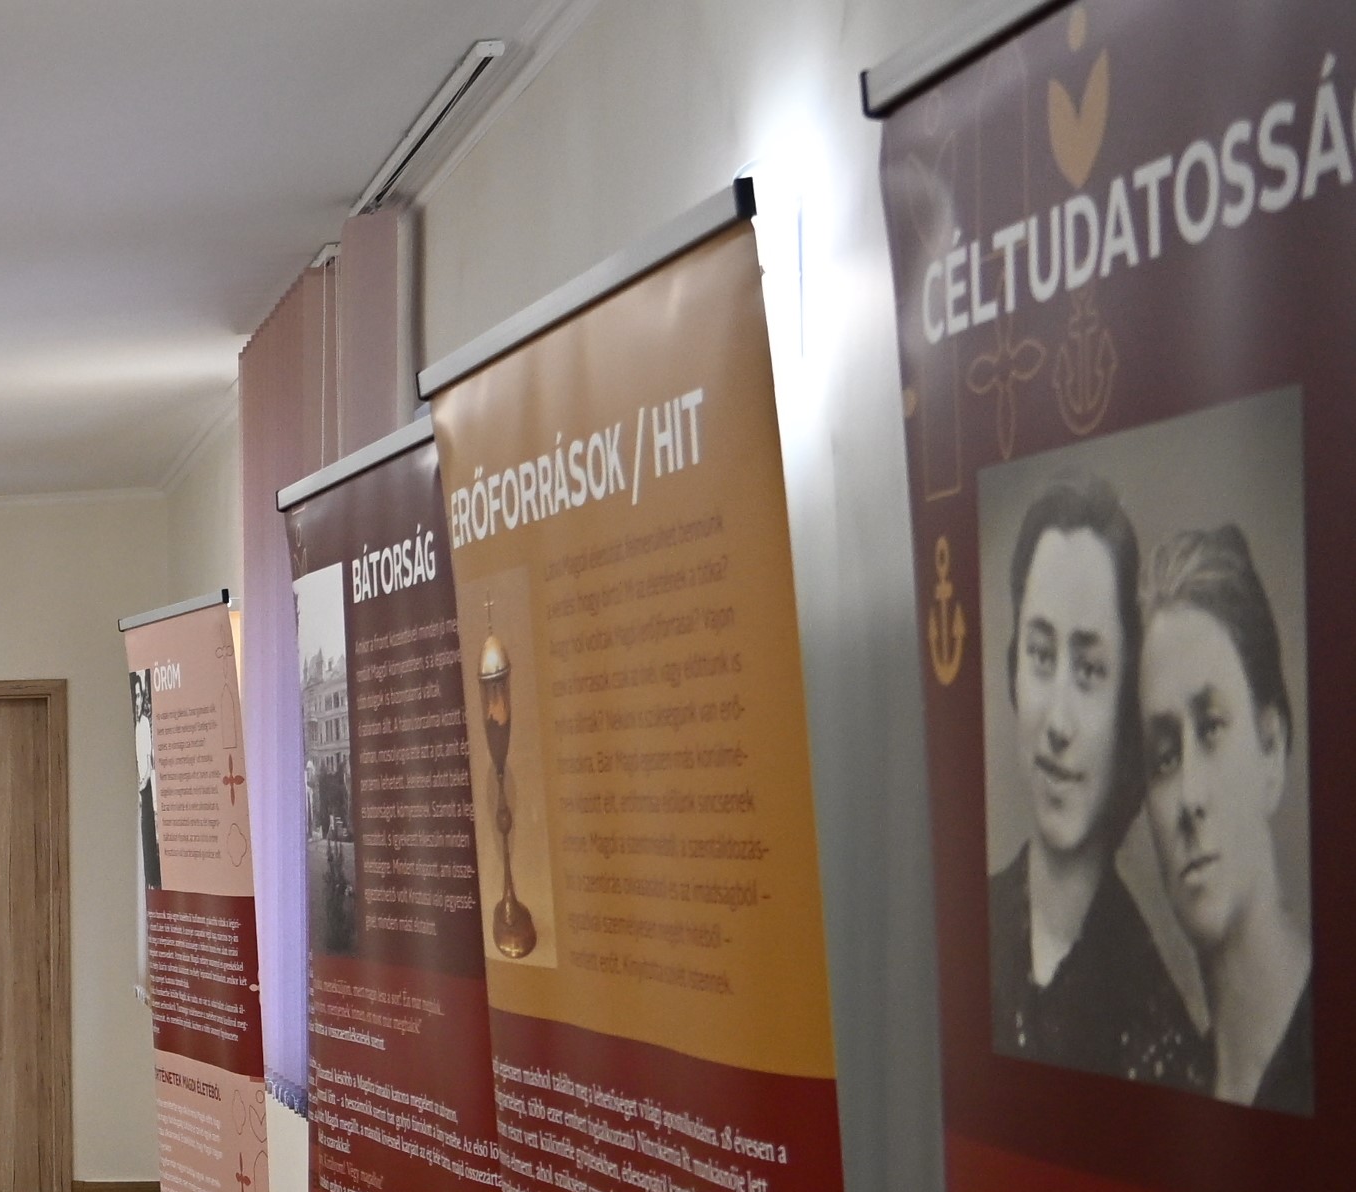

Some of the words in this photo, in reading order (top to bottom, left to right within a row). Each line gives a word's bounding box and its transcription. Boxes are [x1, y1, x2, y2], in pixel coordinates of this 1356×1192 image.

[922, 52, 1356, 344] CÉLTUDATOSSÁ
[451, 422, 625, 550] ERŐFORRÁSOK
[652, 388, 703, 478] HIT
[351, 523, 436, 605] BÁTORSÁG
[153, 658, 181, 692] ÖRÖM
[733, 1128, 775, 1161] évesen
